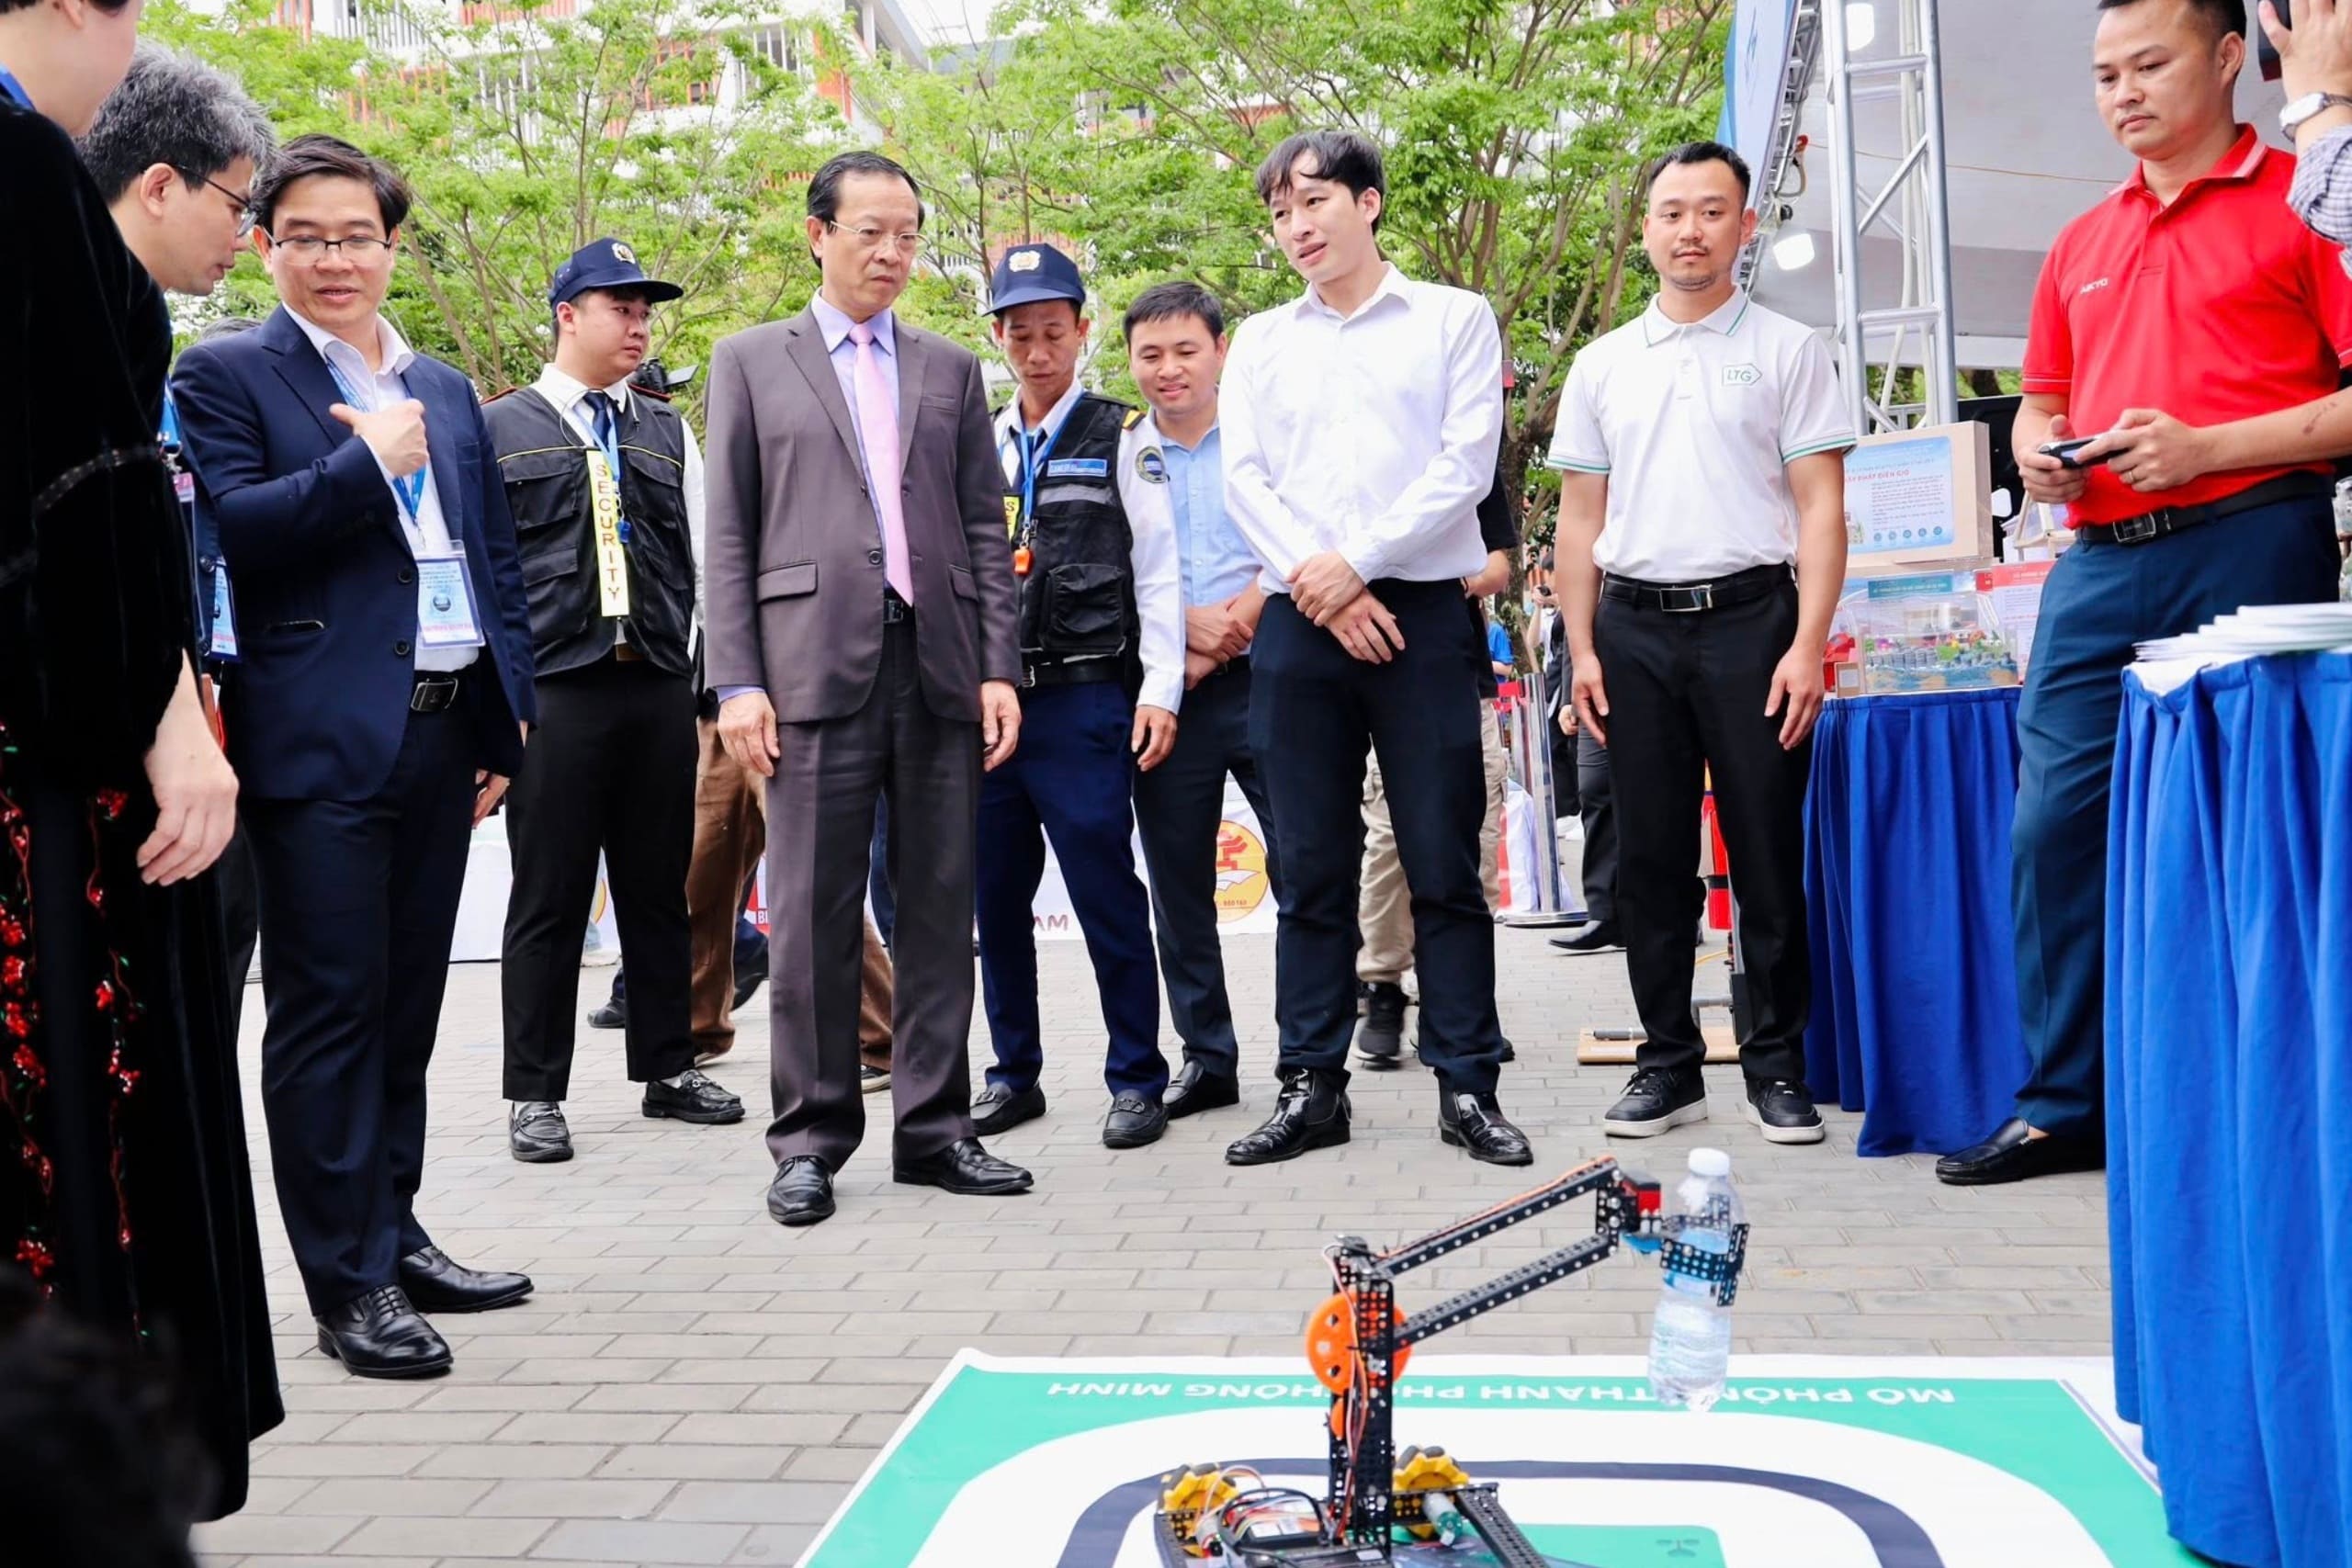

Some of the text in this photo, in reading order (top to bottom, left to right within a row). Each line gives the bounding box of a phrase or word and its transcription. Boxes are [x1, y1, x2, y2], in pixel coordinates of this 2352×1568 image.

[1727, 369, 1752, 382] LTG
[595, 464, 620, 601] SECURITY
[1046, 1382, 1172, 1396] MINH
[1183, 1383, 1331, 1400] HÔNG
[1393, 1384, 1466, 1399] PH
[1723, 1387, 1854, 1405] PHỎN
